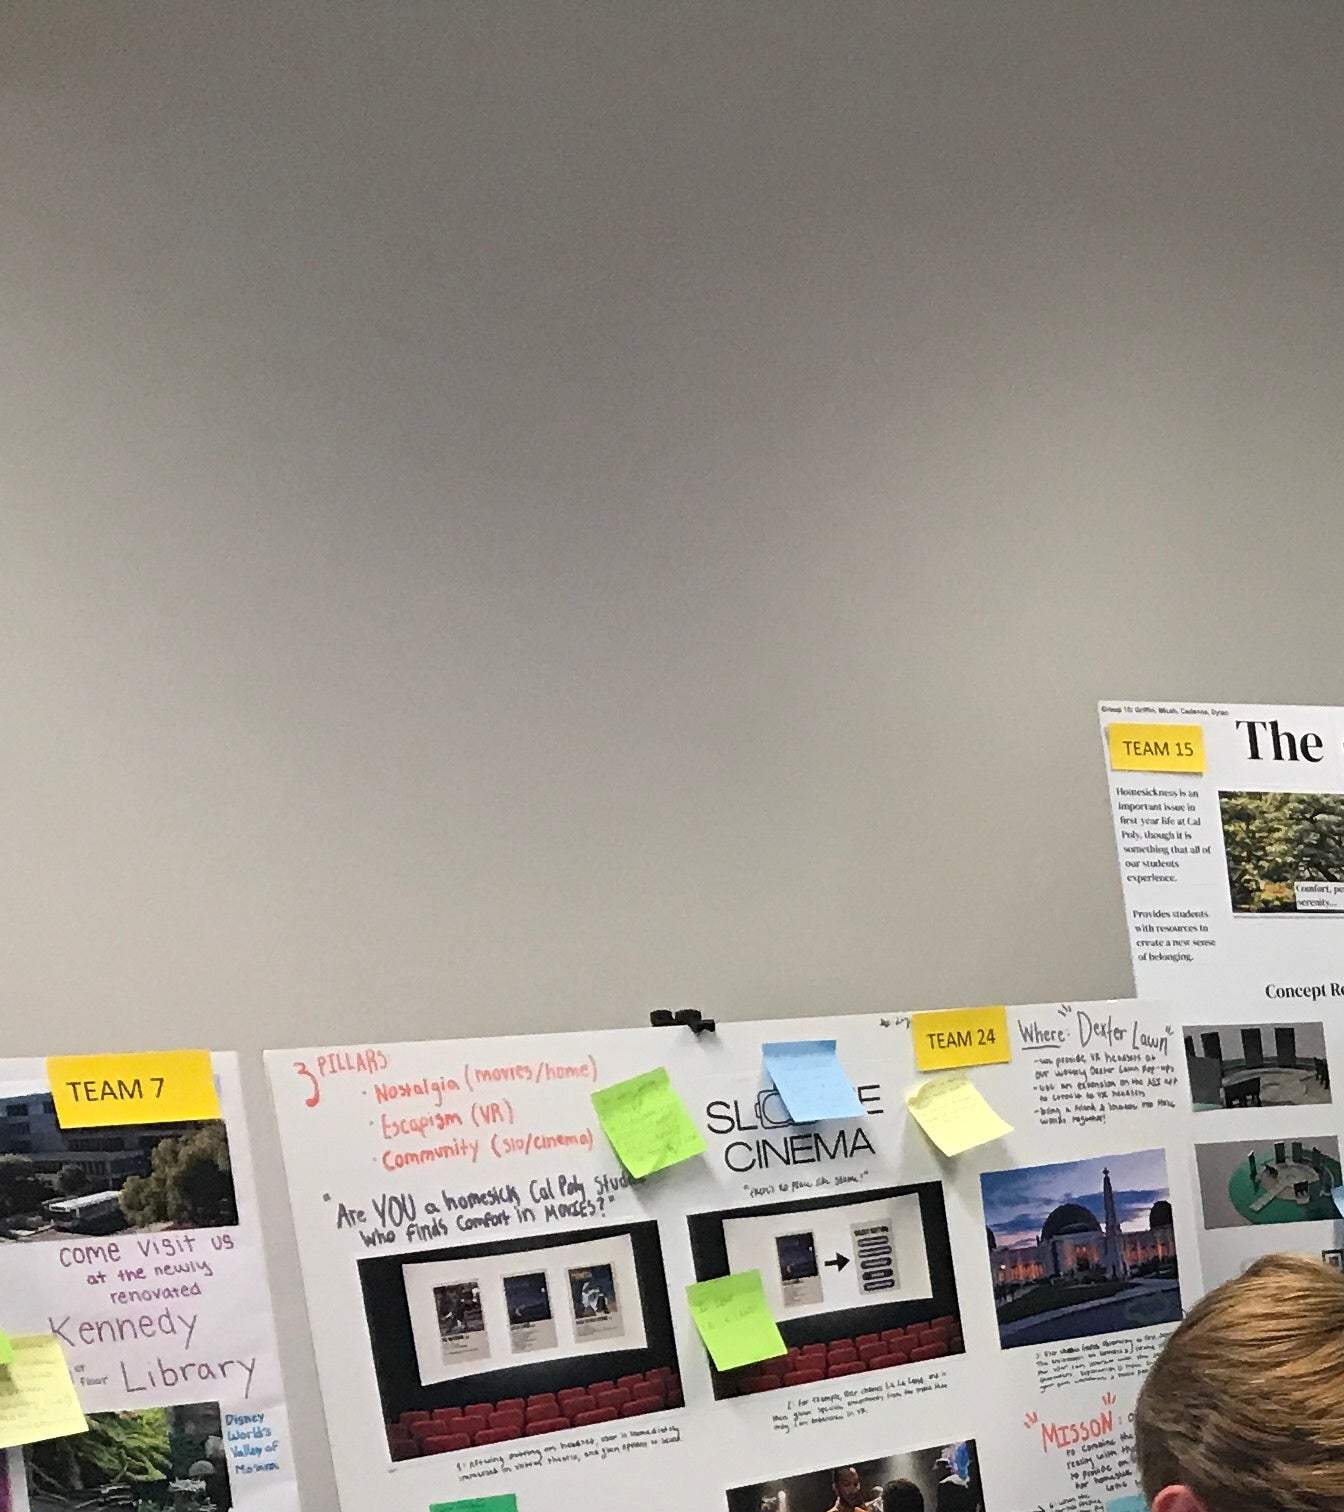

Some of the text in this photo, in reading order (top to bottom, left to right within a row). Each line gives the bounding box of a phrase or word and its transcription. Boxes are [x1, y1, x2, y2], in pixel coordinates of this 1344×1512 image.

[1123, 740, 1194, 758] TEAM 15
[1235, 719, 1324, 763] The
[1264, 983, 1326, 1001] Concept
[926, 1028, 996, 1050] TEAM 24
[66, 1076, 165, 1103] TEAM 7
[373, 1077, 462, 1108] Nostalgia
[382, 1137, 480, 1172] Community
[724, 1127, 878, 1174] CINEMA
[372, 1193, 418, 1228] YOU
[86, 1260, 214, 1286] at the newly
[109, 1282, 203, 1305] renovated
[48, 1306, 199, 1351] Kennedy
[119, 1355, 257, 1401] Library
